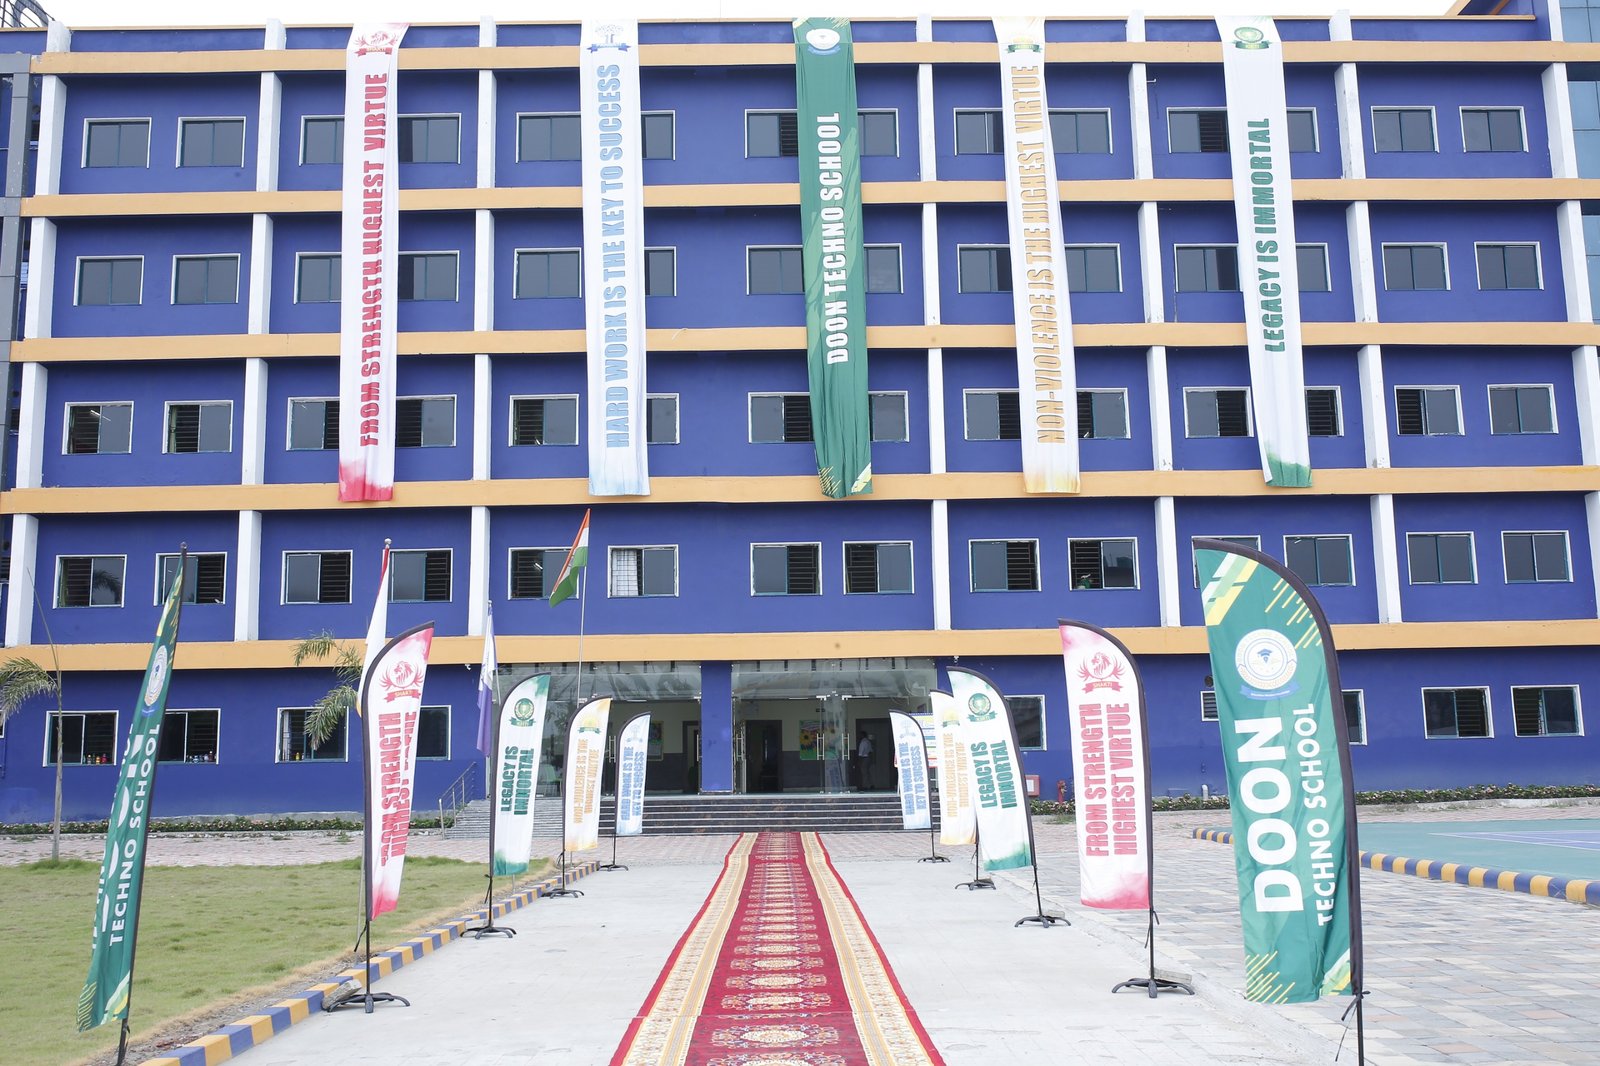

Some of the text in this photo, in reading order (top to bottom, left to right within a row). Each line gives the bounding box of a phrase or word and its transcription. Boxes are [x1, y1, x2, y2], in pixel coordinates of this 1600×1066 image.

[364, 73, 388, 151] VIRTUE
[596, 64, 624, 160] SUCCESS
[1011, 66, 1043, 134] VIRTUE
[362, 160, 385, 255] HIGHEST
[600, 165, 624, 193] TO
[1016, 141, 1050, 224] HIGHEST
[602, 198, 624, 237] KEY
[817, 112, 848, 364] DOON TECHNO SCHOOL
[1024, 228, 1052, 264] THE
[1248, 118, 1286, 352] LEGACY IS IMMORTAL
[602, 240, 626, 282] THE
[1026, 268, 1055, 291] IS
[361, 259, 382, 378] STRENGTH
[603, 285, 626, 308] IS
[604, 312, 628, 382] WORK
[1028, 294, 1066, 444] NON-VIOLENCE
[360, 382, 380, 447] FROM
[606, 386, 630, 448] HARD
[378, 712, 402, 810] STRENGTH
[500, 745, 518, 812] LEGACY IS
[514, 748, 534, 816] IMMORTAL
[970, 741, 989, 758] IS
[974, 758, 998, 809] LEGACY
[990, 740, 1018, 809] IMMORTAL
[1078, 702, 1110, 857] FROM STRENGTH
[1106, 702, 1138, 856] HIGHEST VIRTUE
[110, 839, 137, 946] TECHNO
[128, 724, 160, 828] SCHOOL
[1234, 716, 1304, 912] DOON
[1292, 703, 1336, 927] TECHNO SCHOOL
